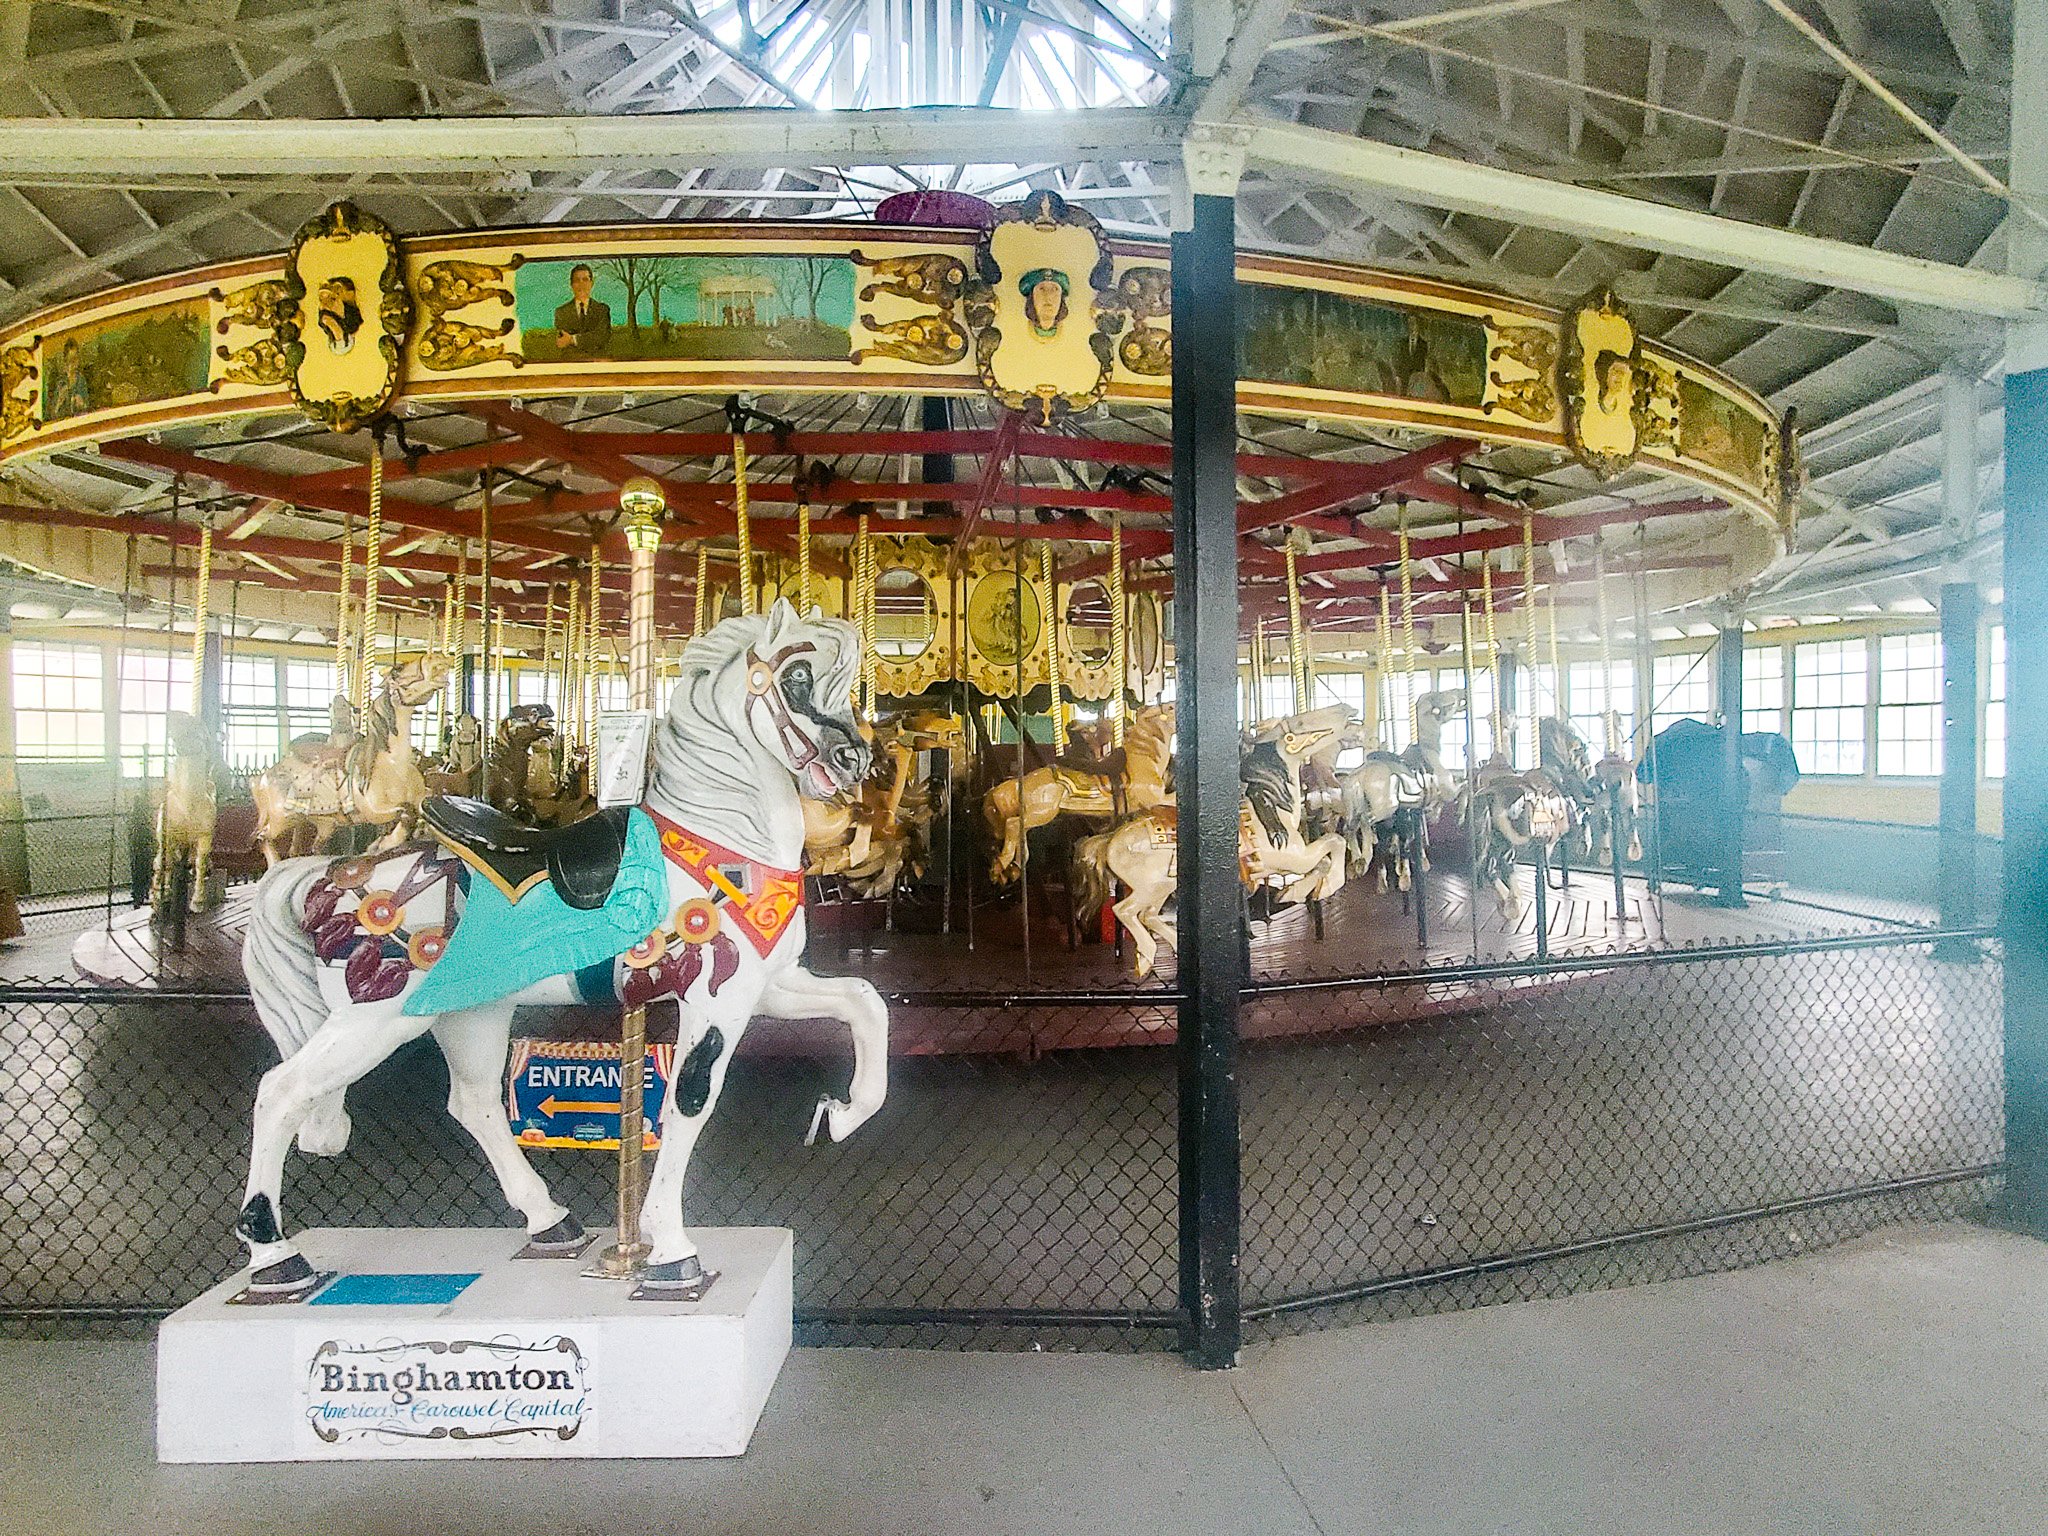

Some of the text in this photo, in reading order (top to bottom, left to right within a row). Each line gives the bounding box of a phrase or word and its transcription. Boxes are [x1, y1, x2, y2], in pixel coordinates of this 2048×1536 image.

[528, 1066, 655, 1089] ENTRANE
[320, 1362, 575, 1406] Binghamton
[306, 1395, 592, 1422] America's Carousel Capital
